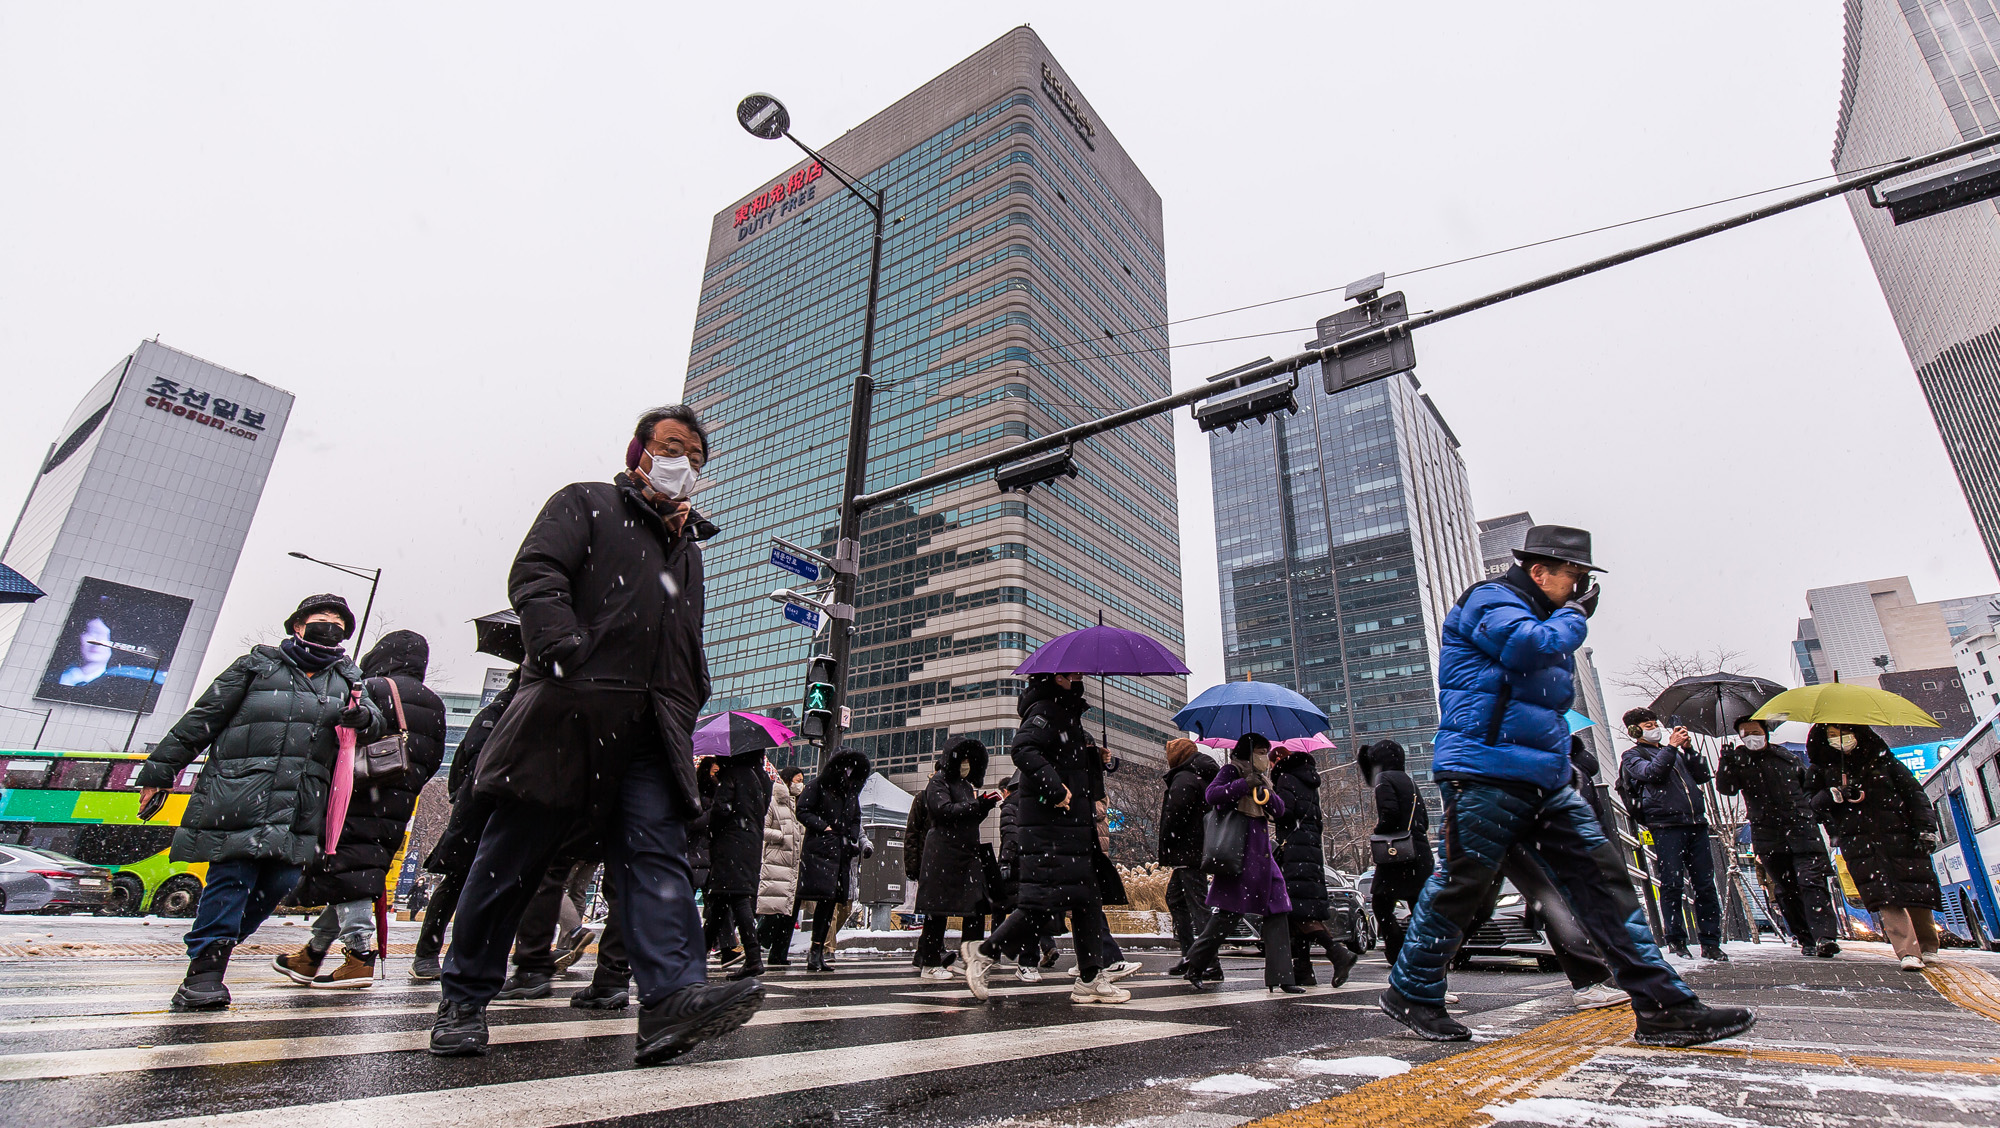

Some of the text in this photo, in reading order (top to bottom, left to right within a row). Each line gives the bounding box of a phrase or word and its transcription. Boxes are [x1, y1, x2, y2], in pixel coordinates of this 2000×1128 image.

[738, 184, 816, 242] DUTY FREE
[145, 396, 258, 441] chosun.com
[146, 376, 266, 431] 조선일보
[773, 551, 798, 566] 새문안로
